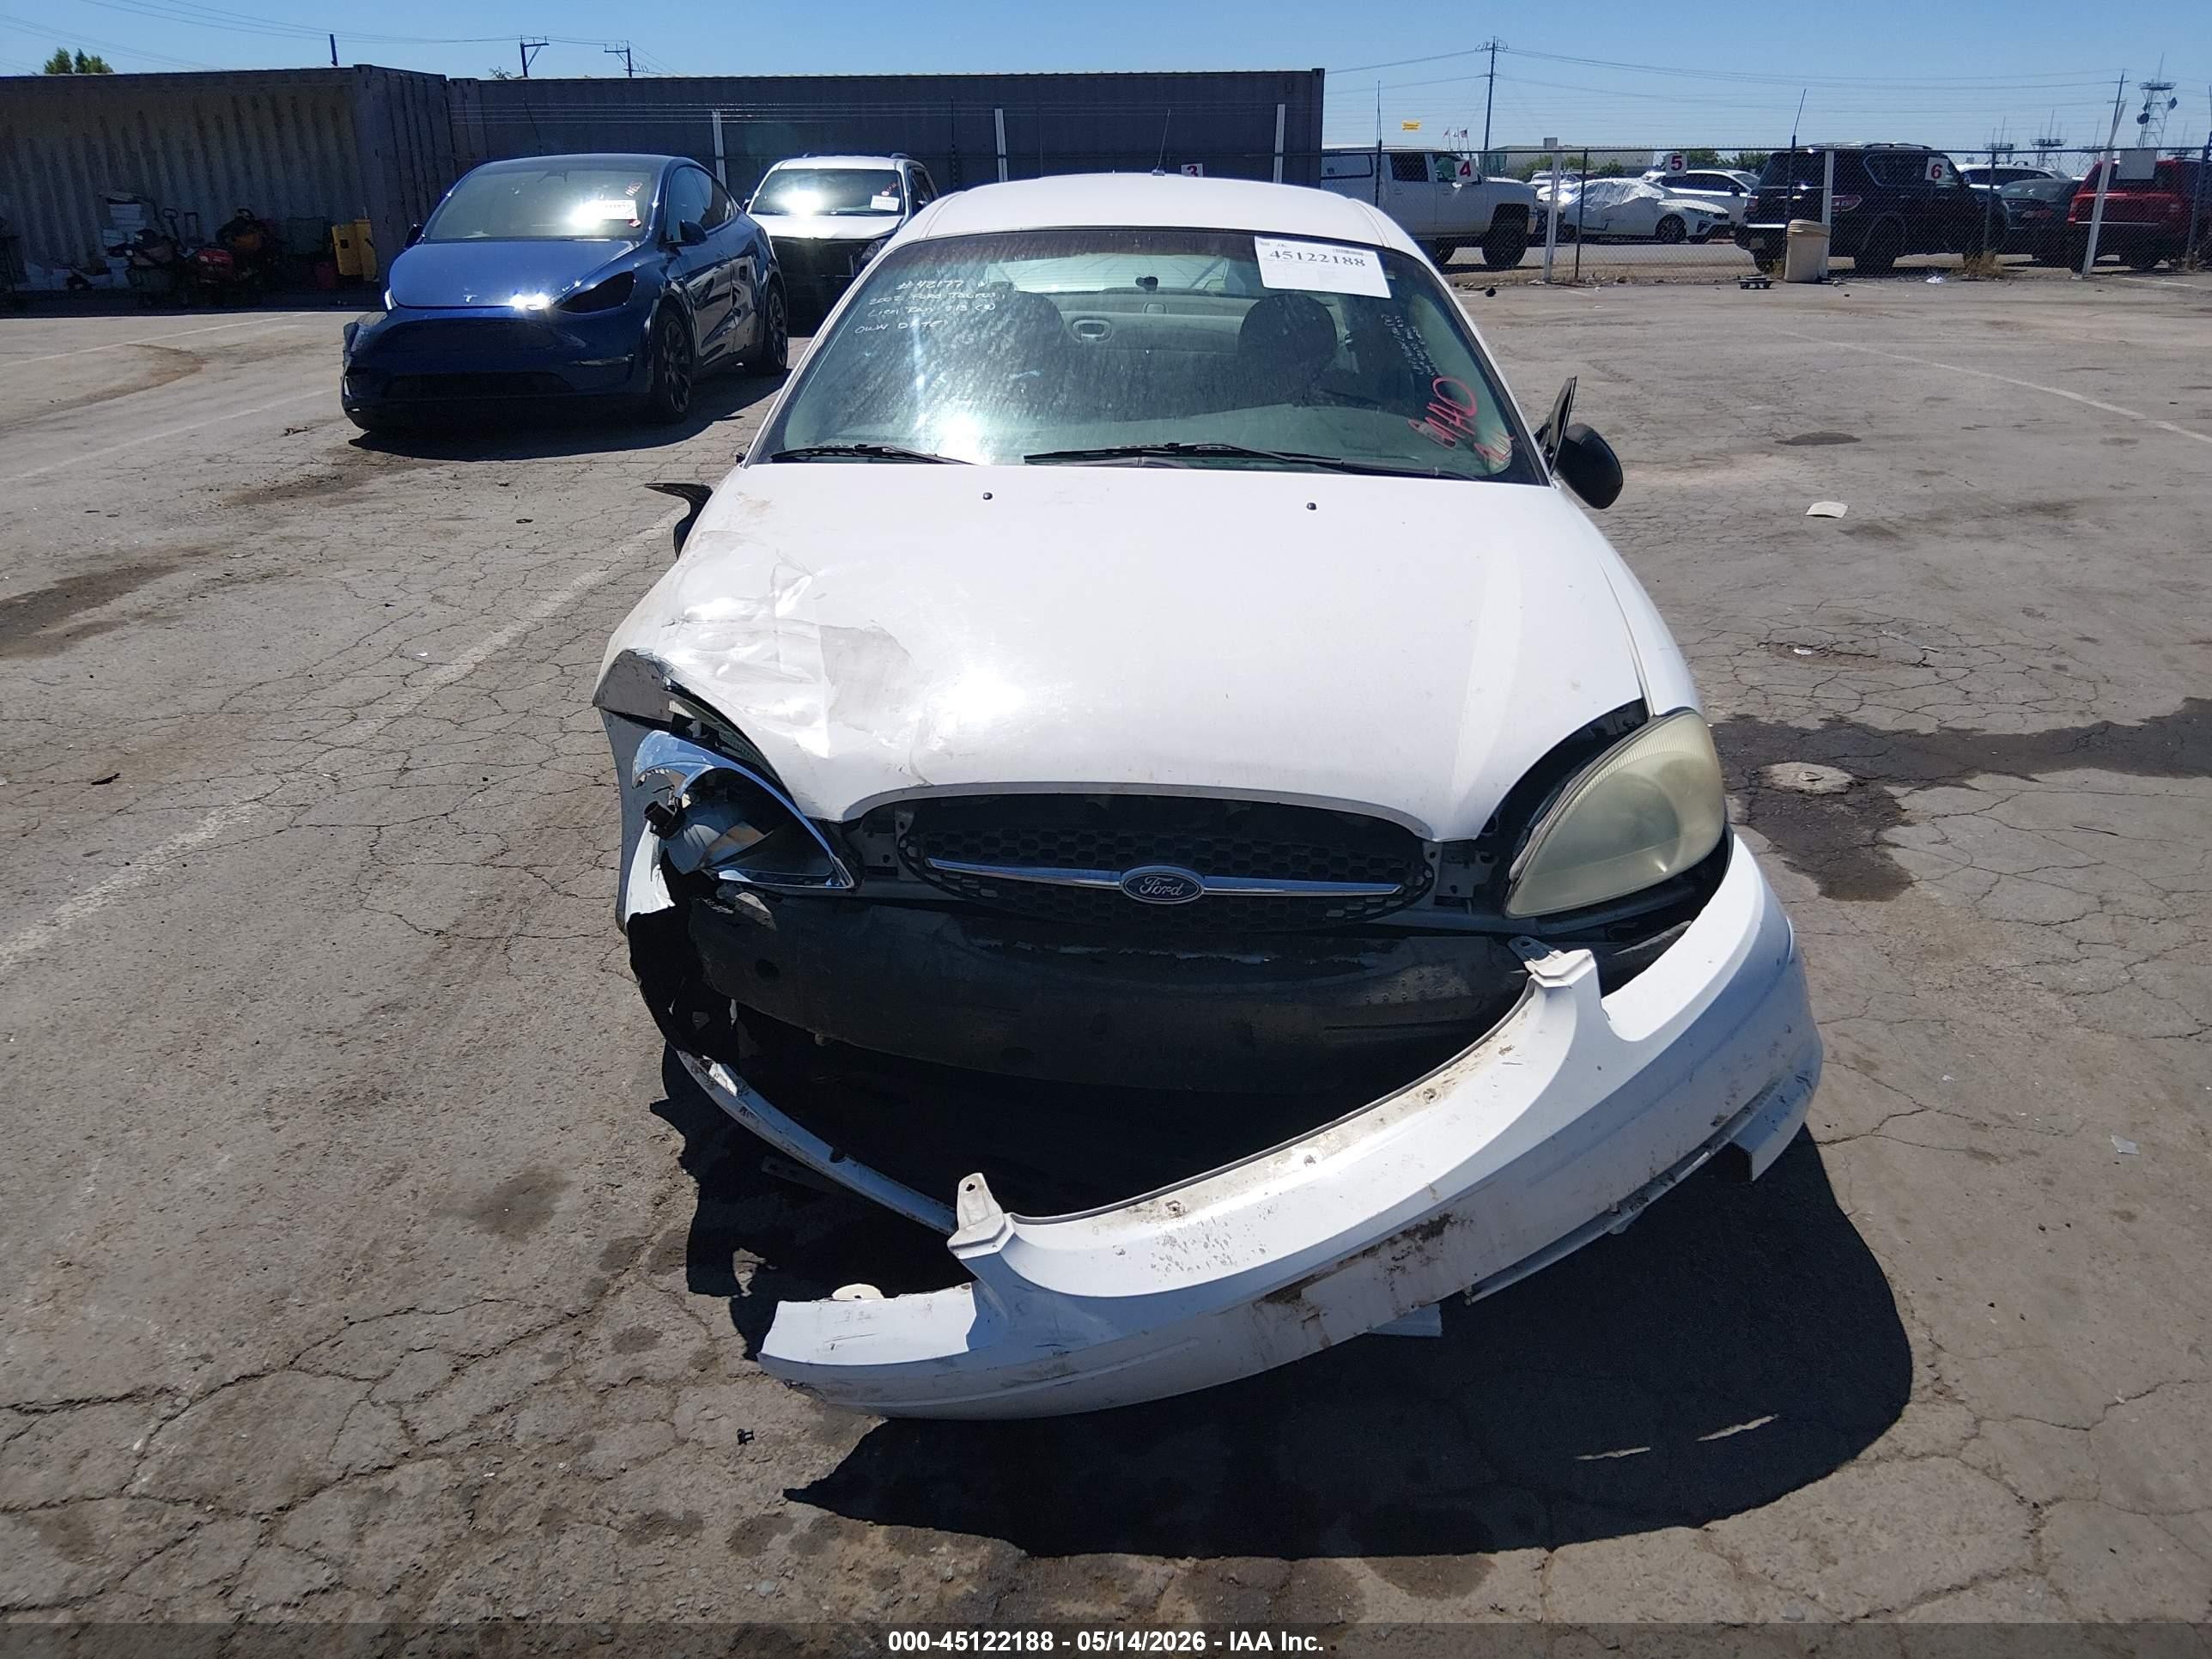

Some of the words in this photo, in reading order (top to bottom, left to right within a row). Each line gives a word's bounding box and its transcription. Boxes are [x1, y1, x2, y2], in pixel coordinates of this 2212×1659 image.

[1187, 165, 1198, 177] 3
[1459, 161, 1472, 177] 4
[1671, 155, 1683, 171] 5
[1930, 163, 1943, 179] 6
[1269, 250, 1366, 267] 45122188
[1139, 876, 1184, 896] Ford
